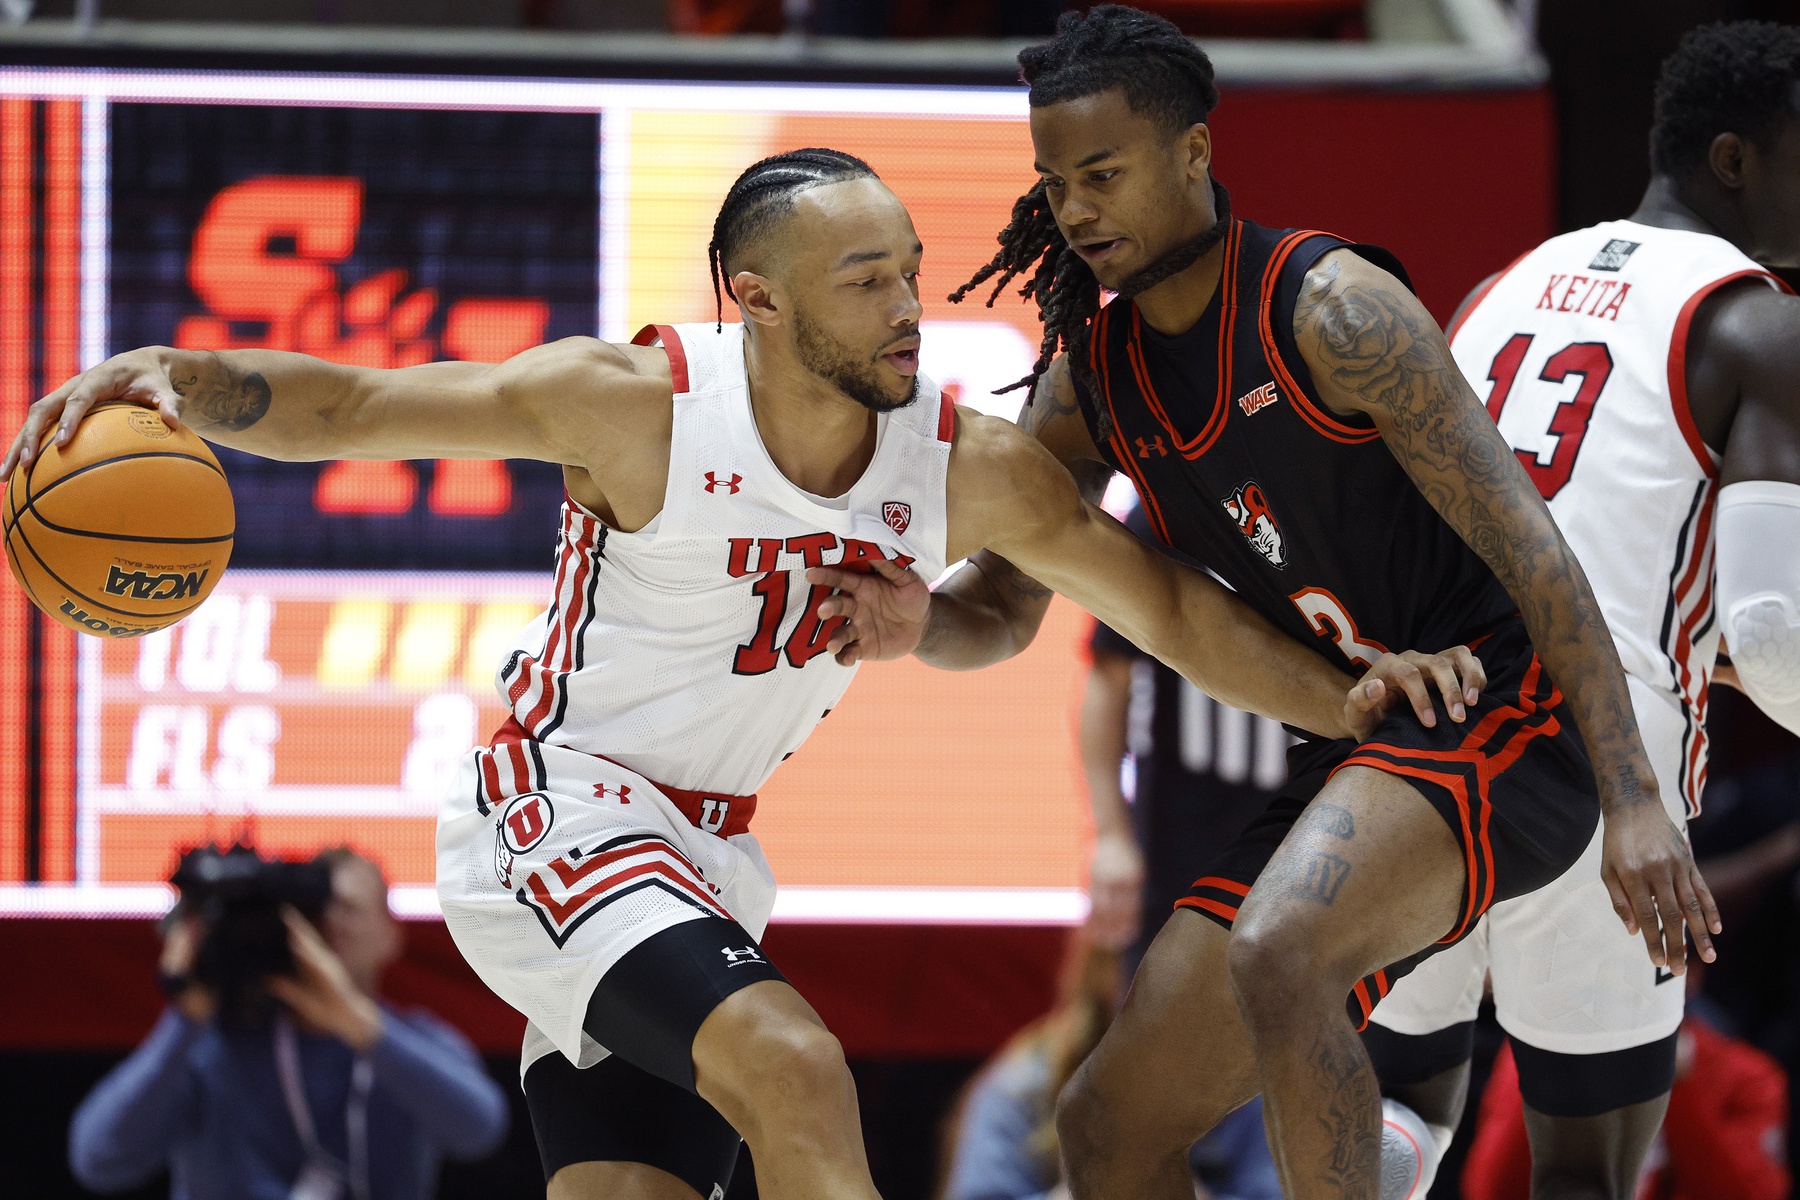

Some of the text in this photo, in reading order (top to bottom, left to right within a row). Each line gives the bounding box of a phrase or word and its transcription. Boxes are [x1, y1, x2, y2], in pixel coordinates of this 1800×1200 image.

[1535, 274, 1632, 322] KEITA
[1238, 381, 1278, 416] WAC
[1485, 333, 1614, 502] 13
[883, 502, 911, 524] PAC
[890, 517, 905, 531] 12
[114, 557, 143, 568] BALL
[144, 562, 175, 571] GAME
[103, 564, 210, 601] NCAA
[1288, 586, 1391, 679] 3
[507, 798, 544, 847] U
[699, 798, 729, 834] U
